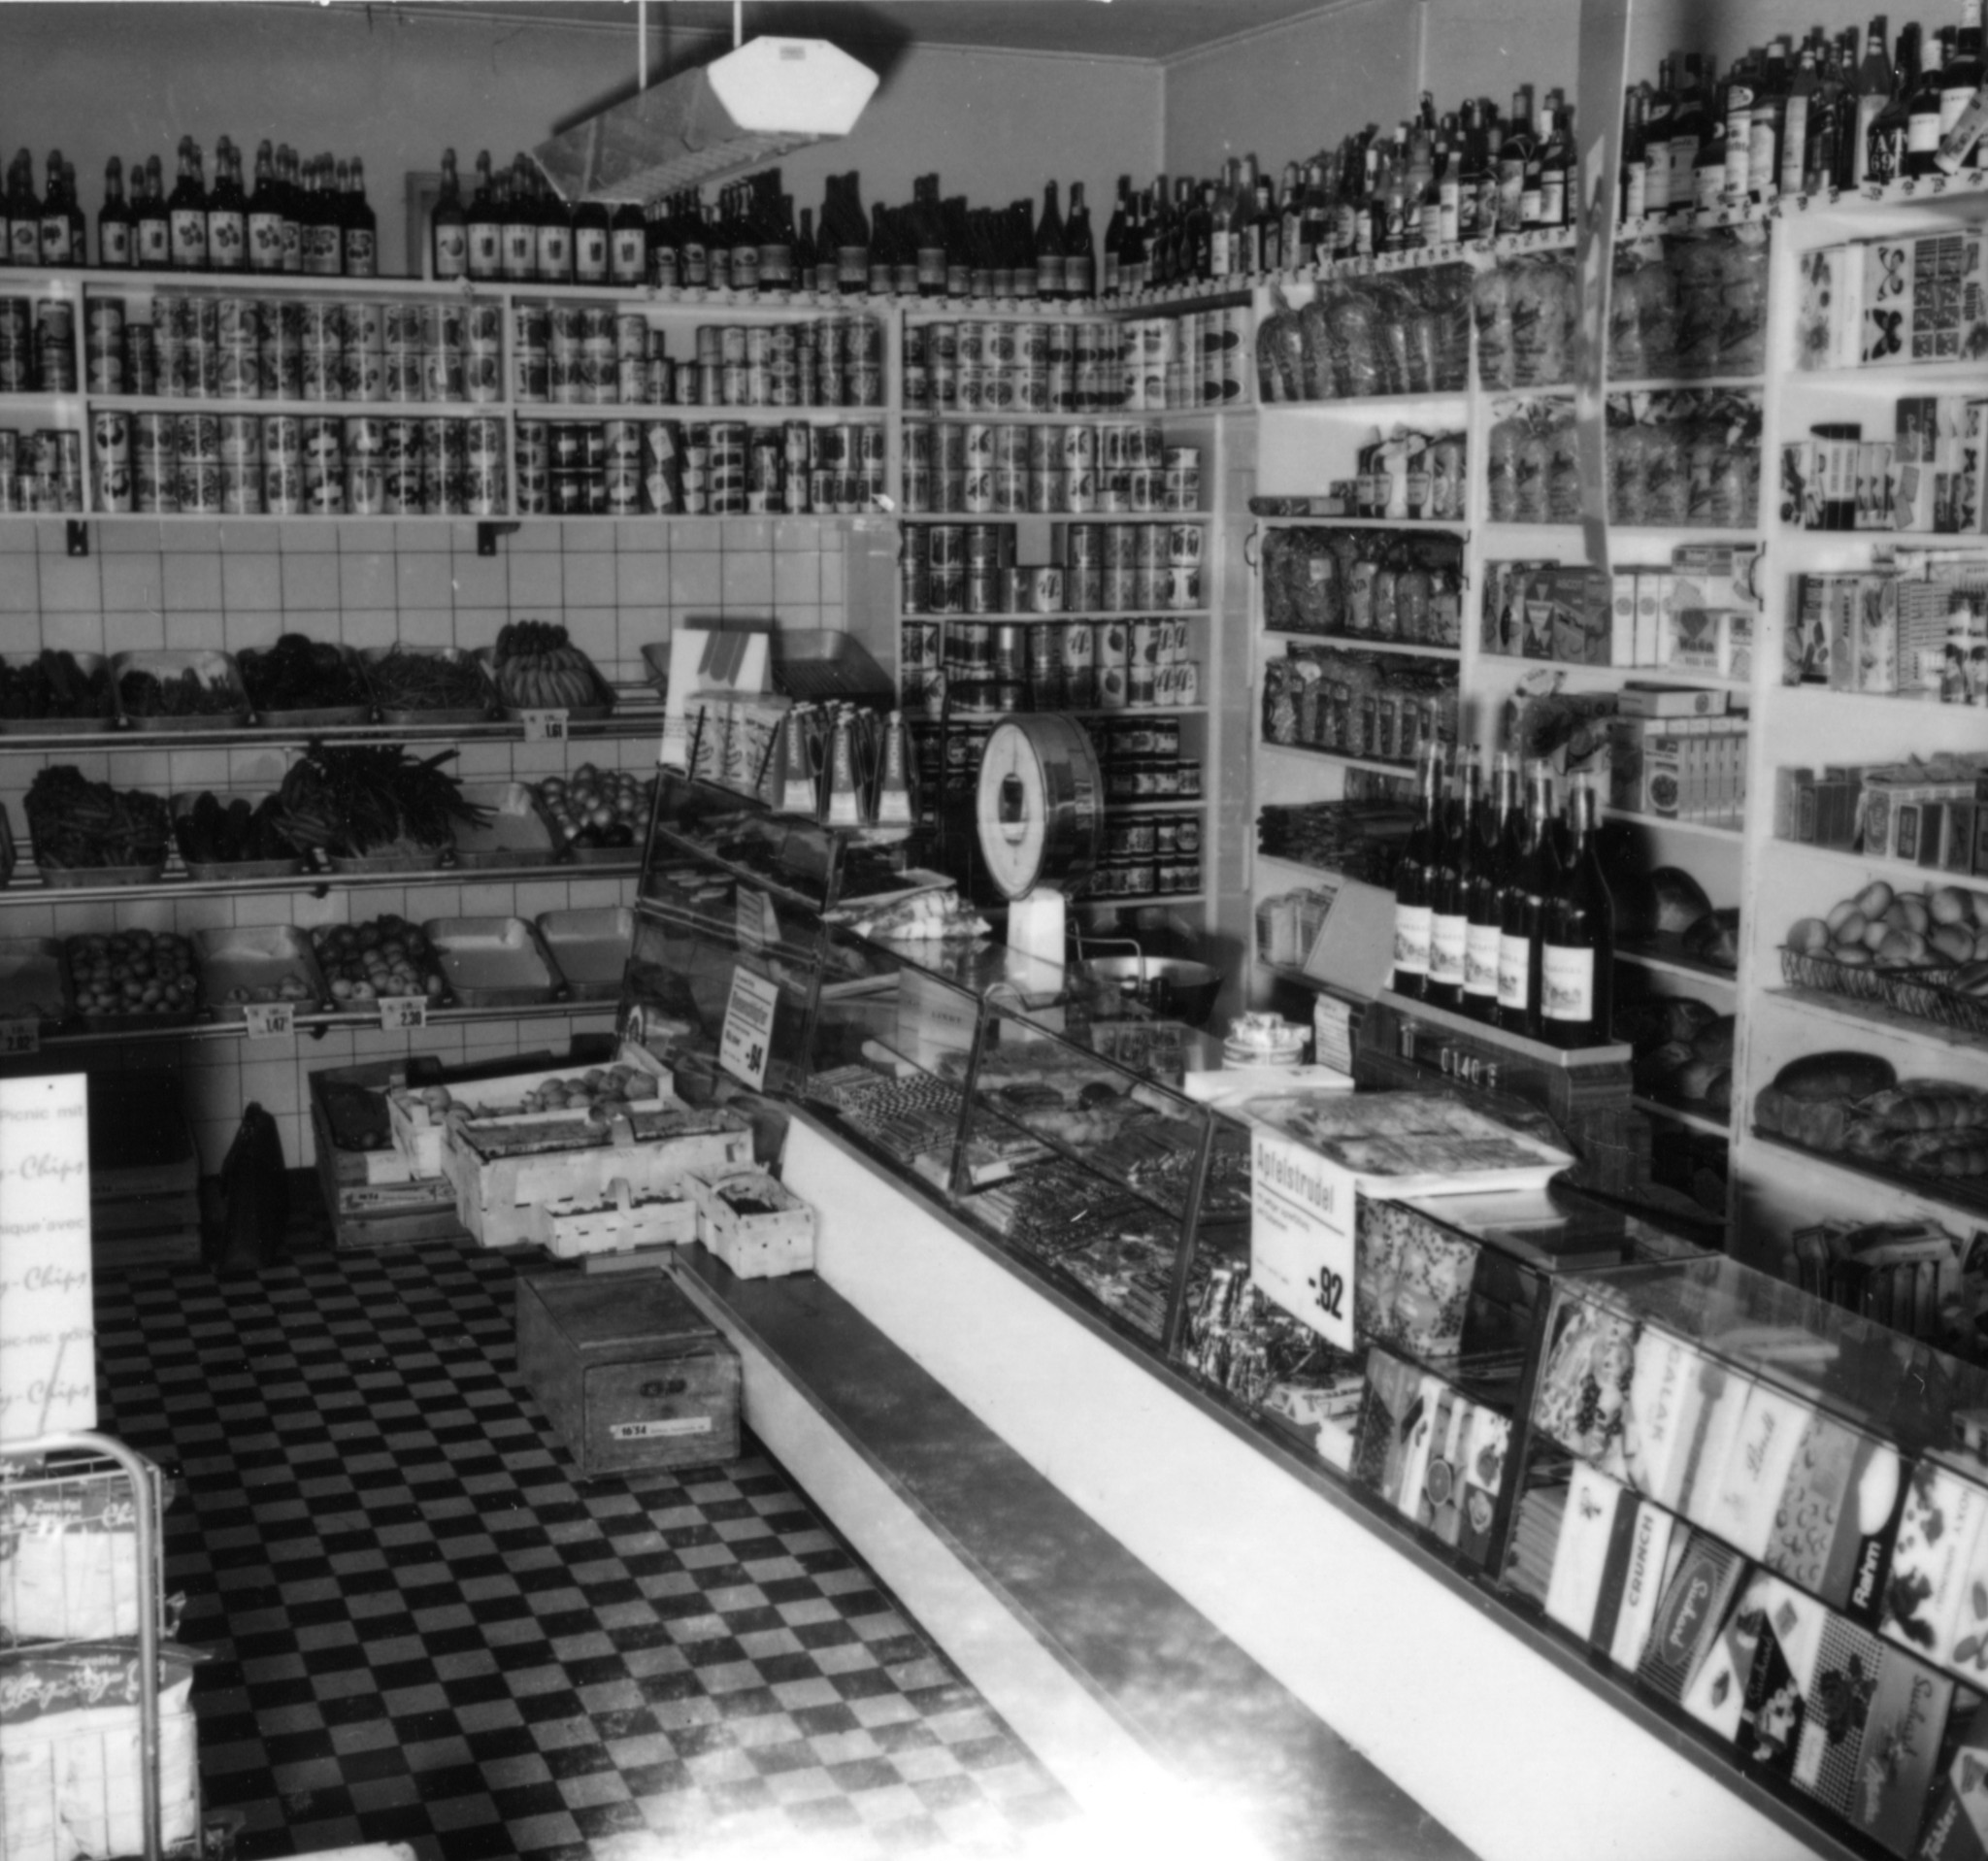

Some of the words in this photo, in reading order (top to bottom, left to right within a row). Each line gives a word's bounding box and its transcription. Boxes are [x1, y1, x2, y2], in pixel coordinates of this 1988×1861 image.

[57, 1105, 84, 1118] mit
[0, 1154, 85, 1182] -Chips
[1256, 1142, 1336, 1214] Apfelstrudel
[47, 1217, 86, 1231] avec
[1628, 1513, 1655, 1609] CRUNCH
[1852, 1540, 1883, 1611] Rahm
[1669, 1577, 1709, 1649] Suchard
